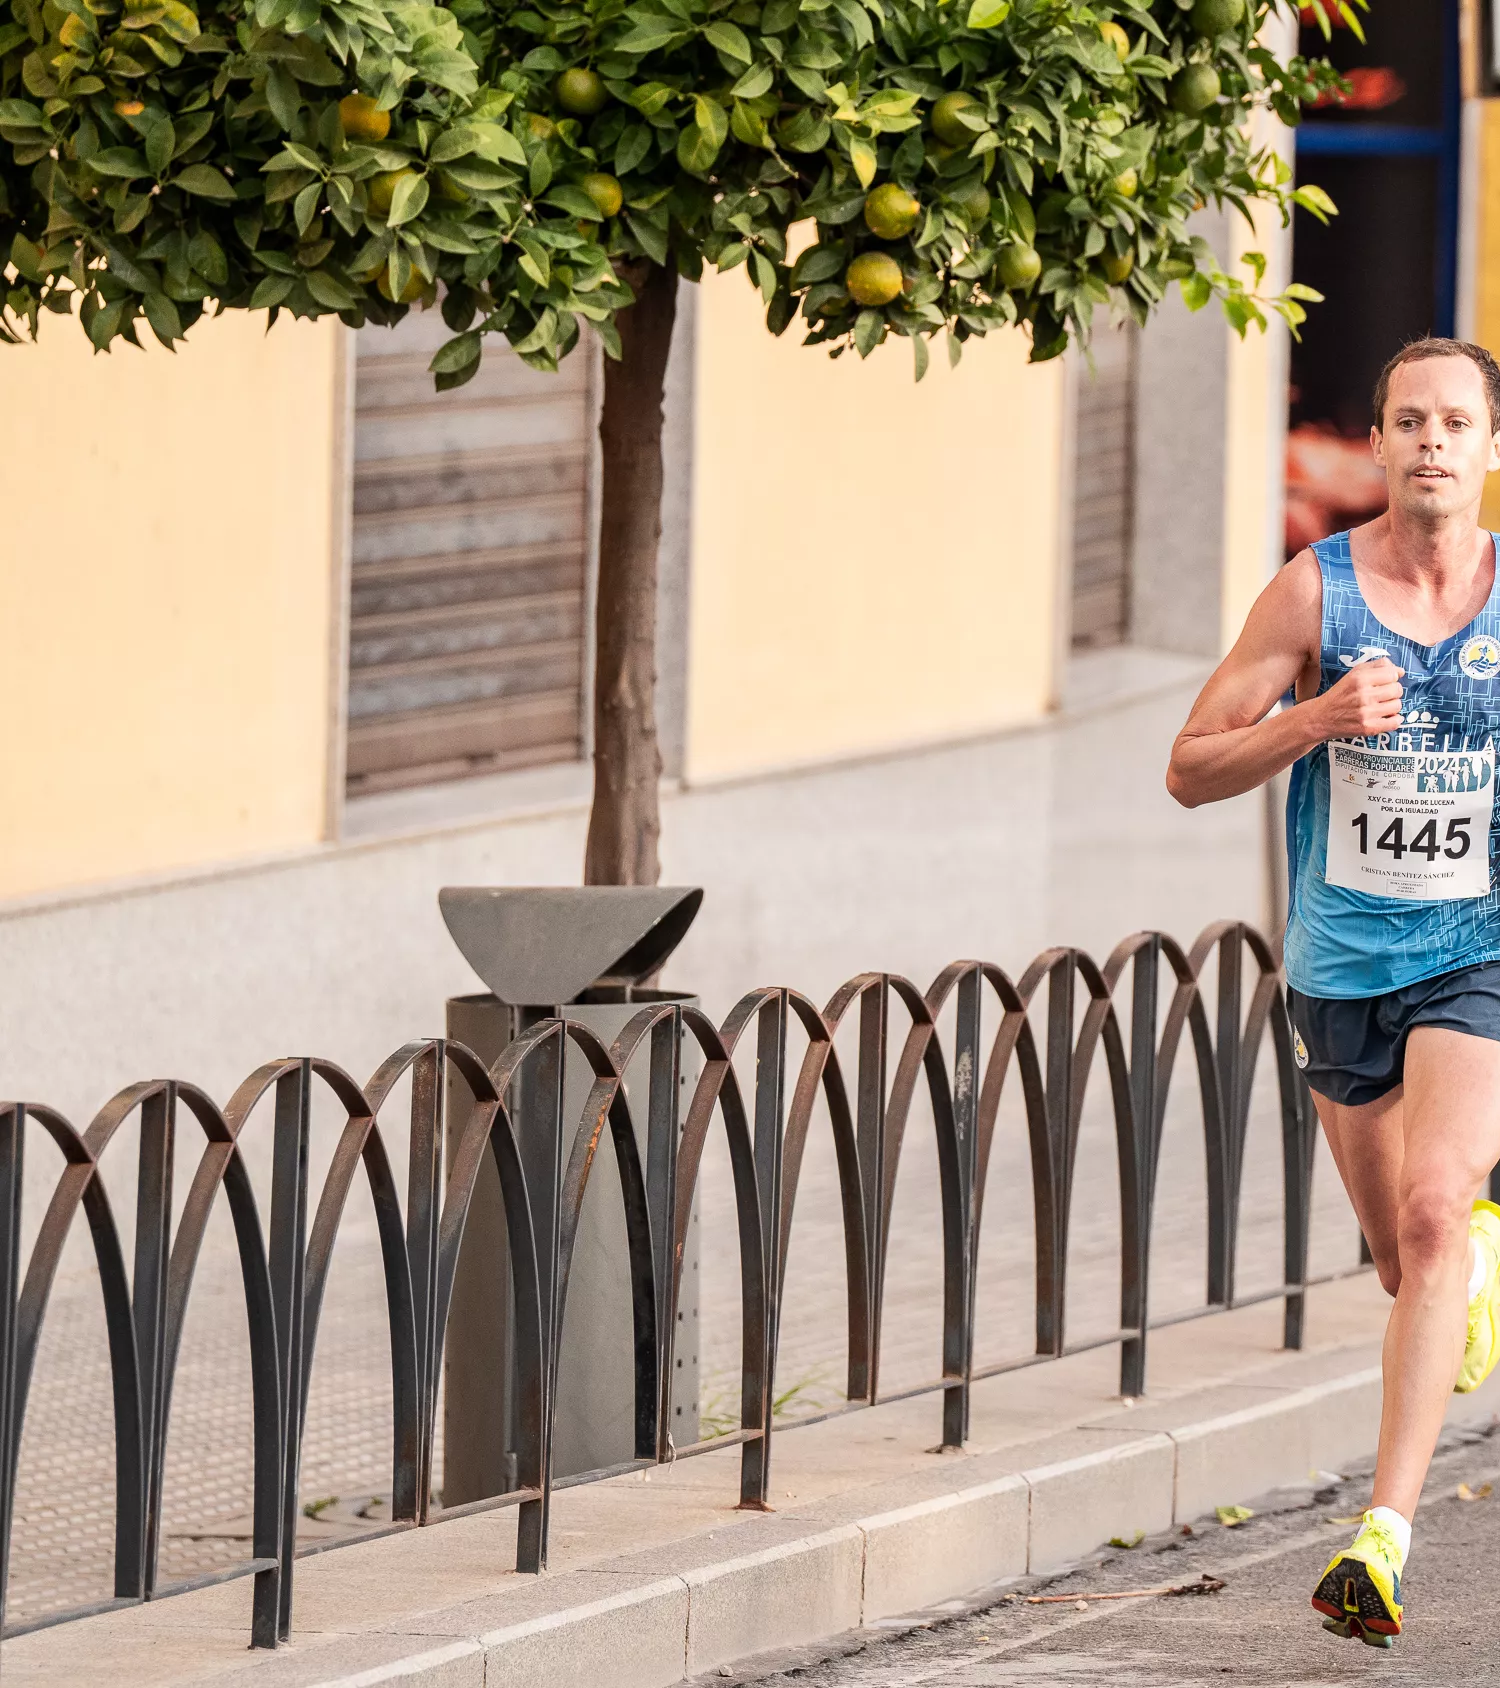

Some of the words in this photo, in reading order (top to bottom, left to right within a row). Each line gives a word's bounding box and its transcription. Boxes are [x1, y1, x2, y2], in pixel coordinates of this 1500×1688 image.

[1335, 748, 1361, 760] CIRCUITO
[1363, 755, 1404, 764] PROVINCIAL
[1335, 754, 1368, 768] CARRERAS
[1371, 763, 1415, 773] POPULARES
[1417, 757, 1461, 773] 2024
[1352, 813, 1471, 861] 1445
[1361, 866, 1391, 876] CRISTIAN
